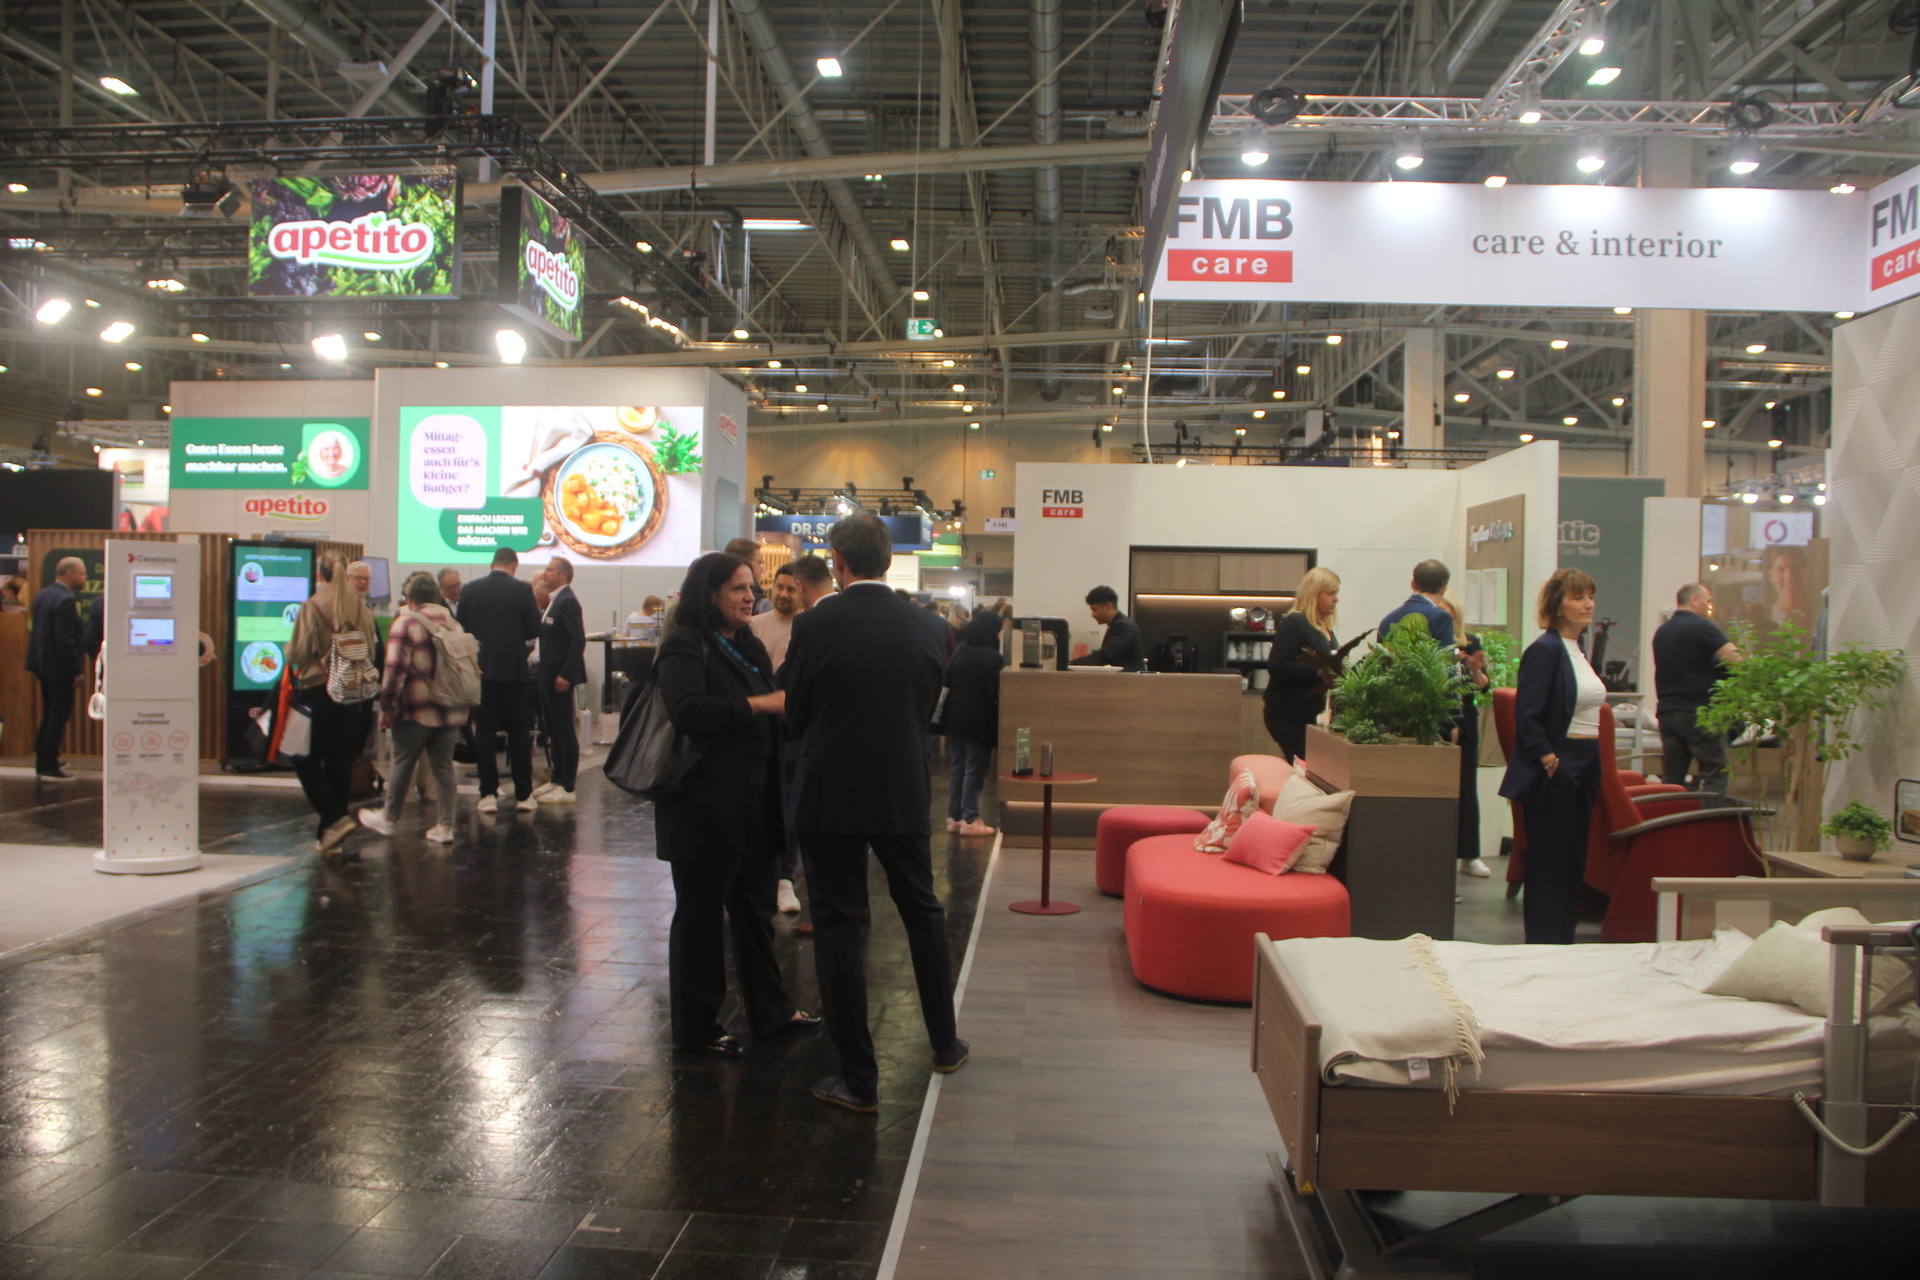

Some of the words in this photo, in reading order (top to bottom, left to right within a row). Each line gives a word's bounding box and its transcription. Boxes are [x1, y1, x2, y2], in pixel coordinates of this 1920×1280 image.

[1168, 196, 1293, 240] FMB
[1872, 183, 1920, 248] FM
[274, 216, 427, 258] apetito
[1473, 233, 1545, 255] care
[1556, 230, 1580, 255] &
[1591, 229, 1723, 258] interior
[528, 245, 577, 298] apetito
[1192, 256, 1268, 275] care
[424, 432, 463, 442] Mittag-
[218, 443, 252, 456] Essen
[252, 443, 285, 456] heute
[424, 446, 455, 454] essen
[424, 458, 450, 467] auch
[424, 470, 458, 479] kleine
[424, 483, 469, 494] Budget?
[1042, 489, 1084, 504] FMB
[245, 494, 328, 516] apetito
[1050, 508, 1076, 516] care
[457, 514, 491, 524] EINFACH
[457, 525, 474, 534] DAS
[475, 525, 510, 534] MACHEN
[511, 526, 528, 535] WIR
[1579, 547, 1600, 556] Trust
